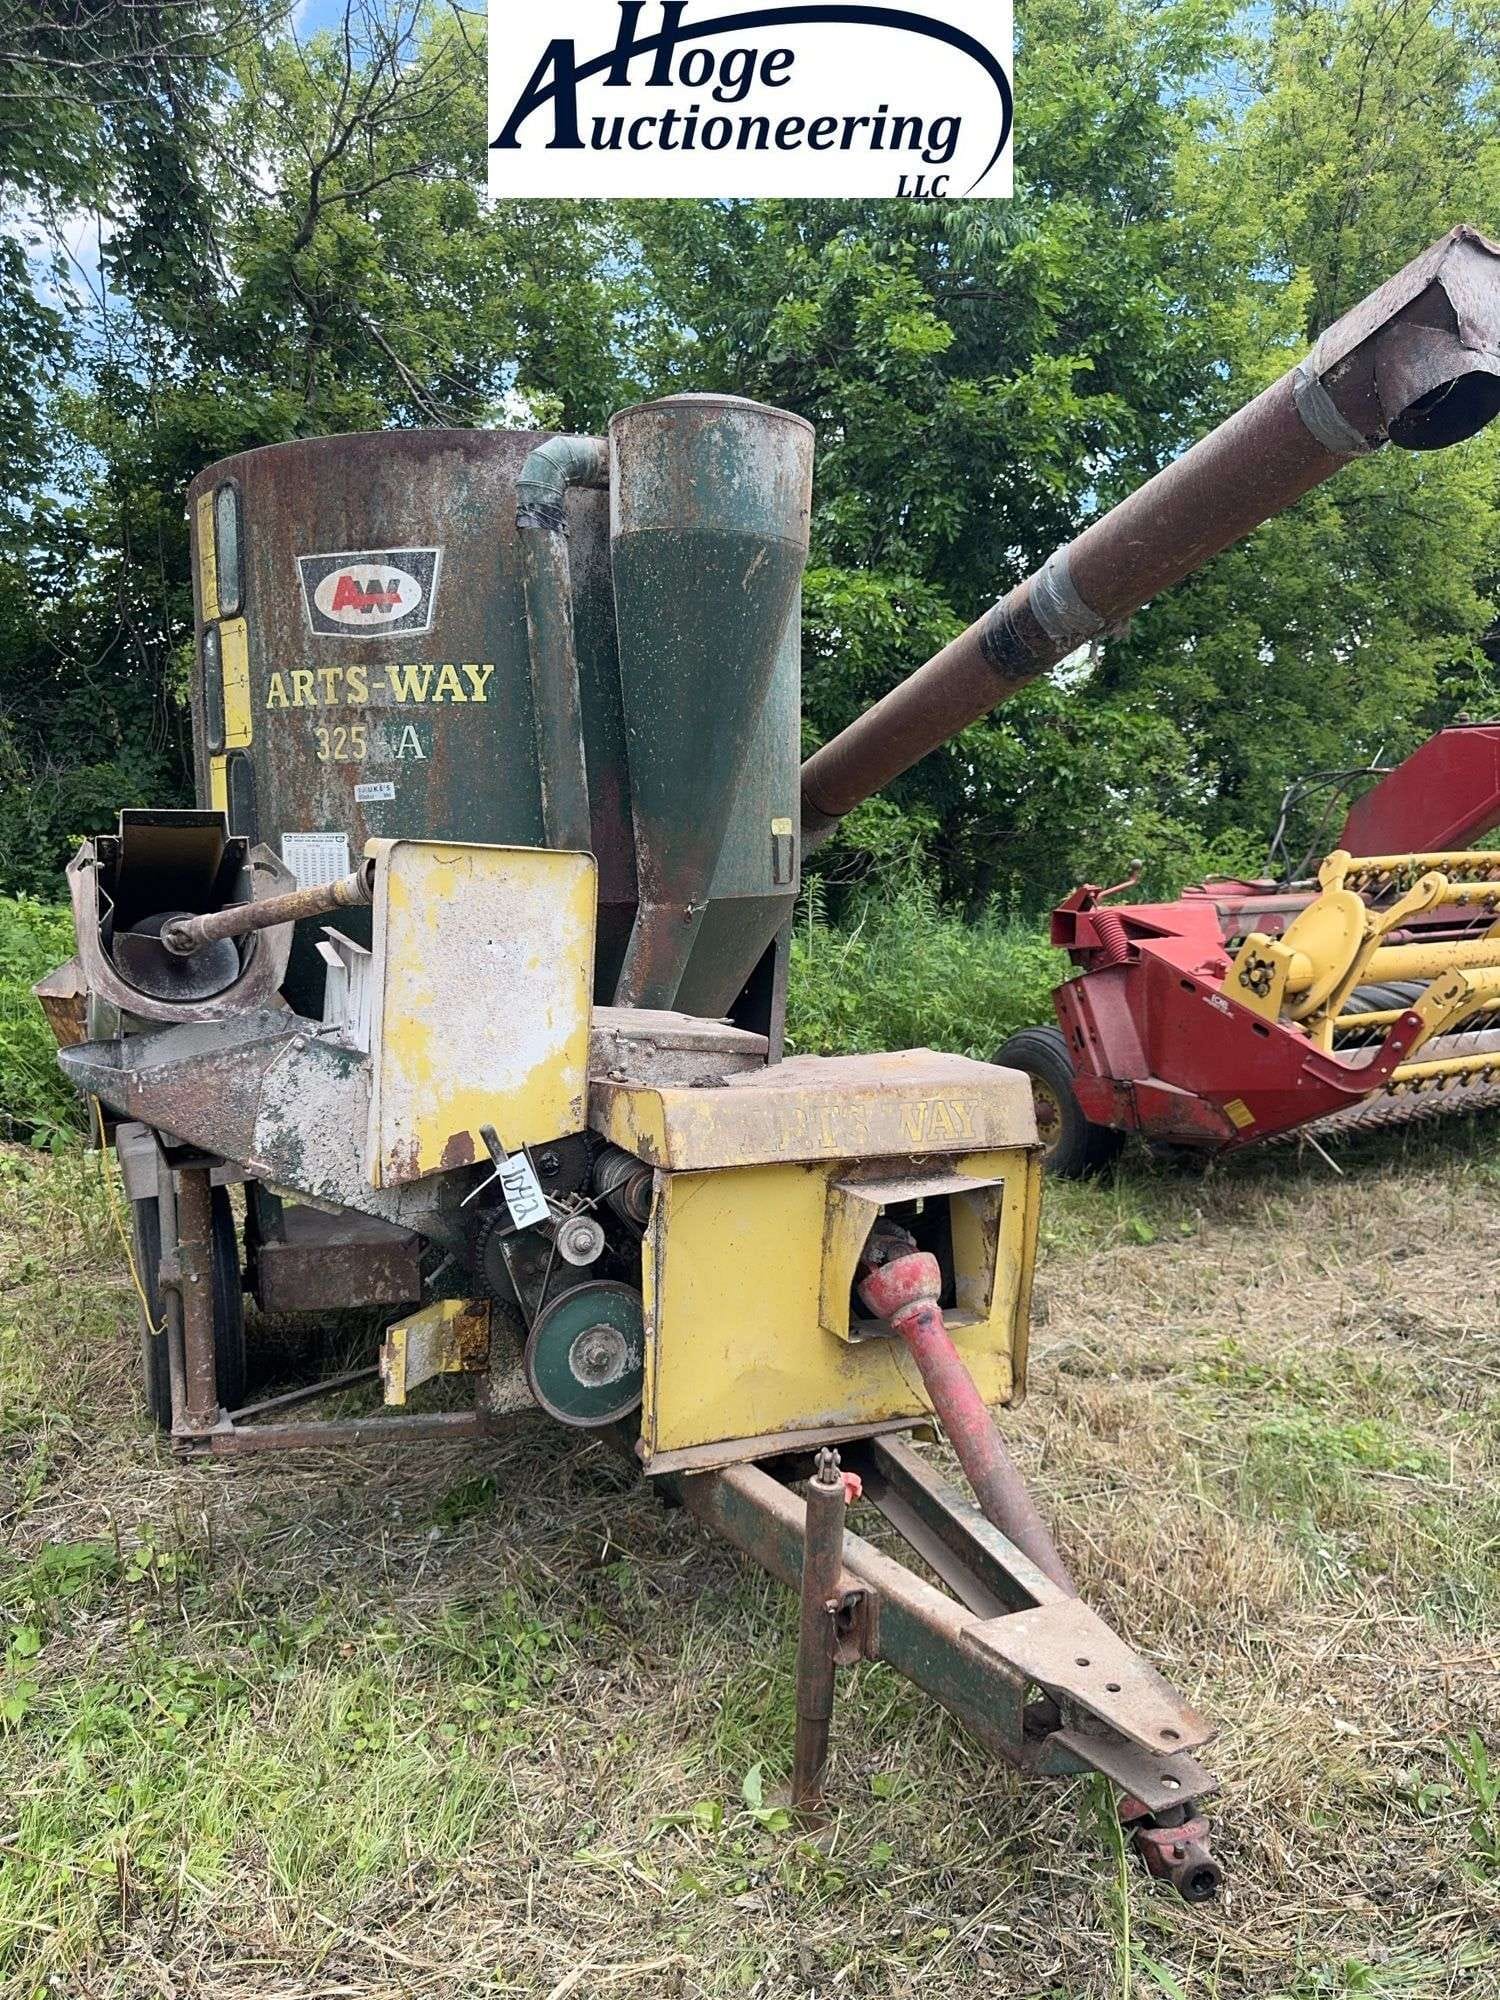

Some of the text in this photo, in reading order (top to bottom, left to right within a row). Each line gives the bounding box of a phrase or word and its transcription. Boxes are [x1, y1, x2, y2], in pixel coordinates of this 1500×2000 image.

[265, 664, 495, 709] ARTS-WAY
[314, 726, 368, 760] 325
[502, 1168, 539, 1220] 1042
